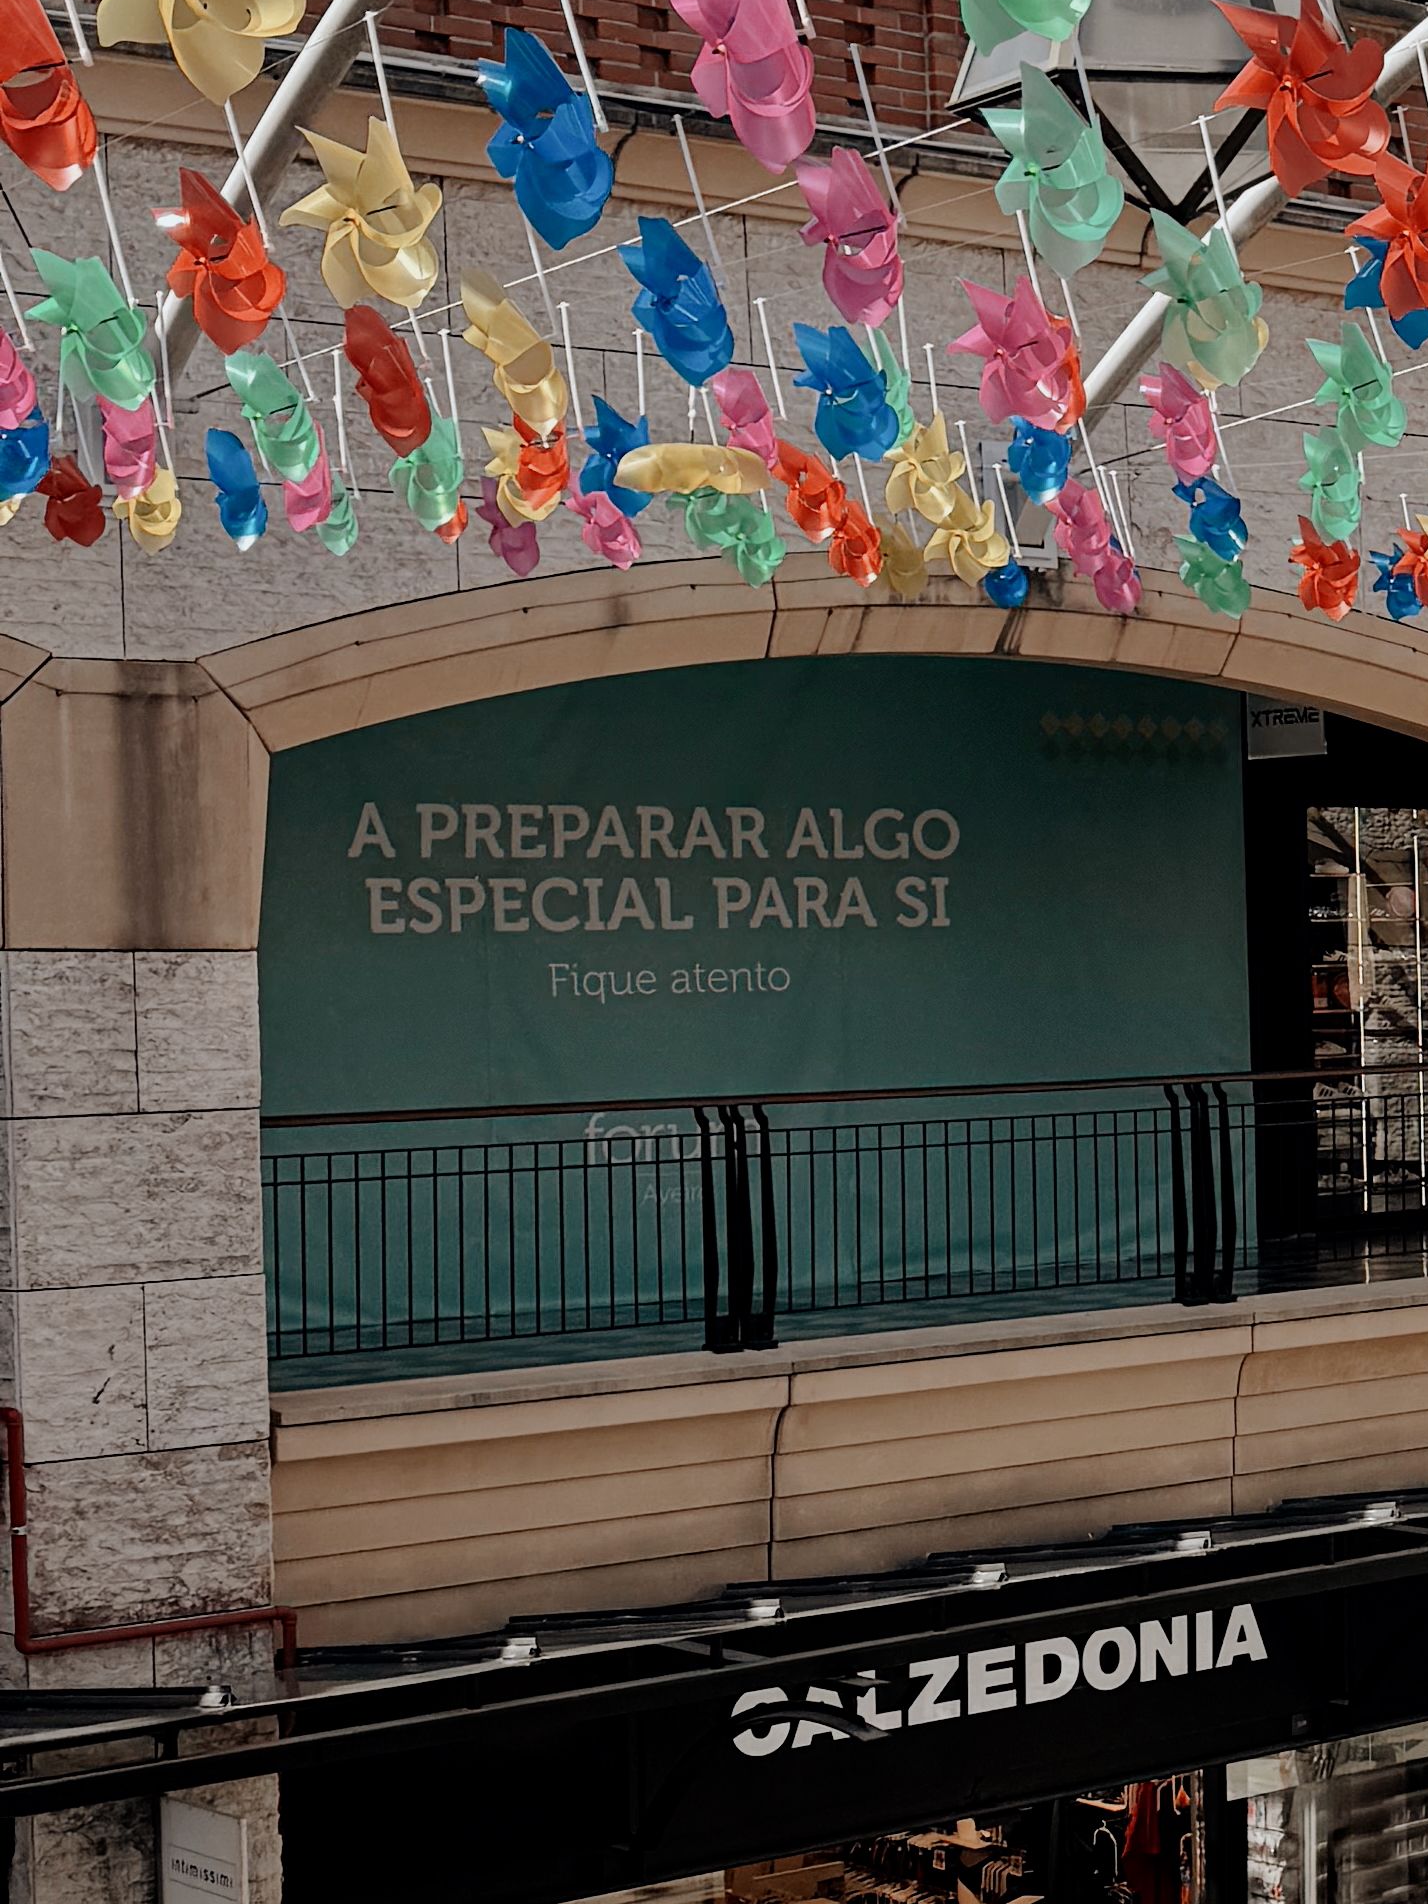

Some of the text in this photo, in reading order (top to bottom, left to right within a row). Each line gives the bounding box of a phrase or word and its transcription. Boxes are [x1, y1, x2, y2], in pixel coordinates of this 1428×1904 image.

[1250, 706, 1320, 728] XTREME
[348, 802, 962, 861] A PREPARAR ALGO
[365, 875, 951, 934] ESPECIAL PARA SI
[549, 961, 792, 1004] Fique atento
[729, 1602, 1268, 1757] CALZEDONIA
[170, 1857, 234, 1890] intimissimi
